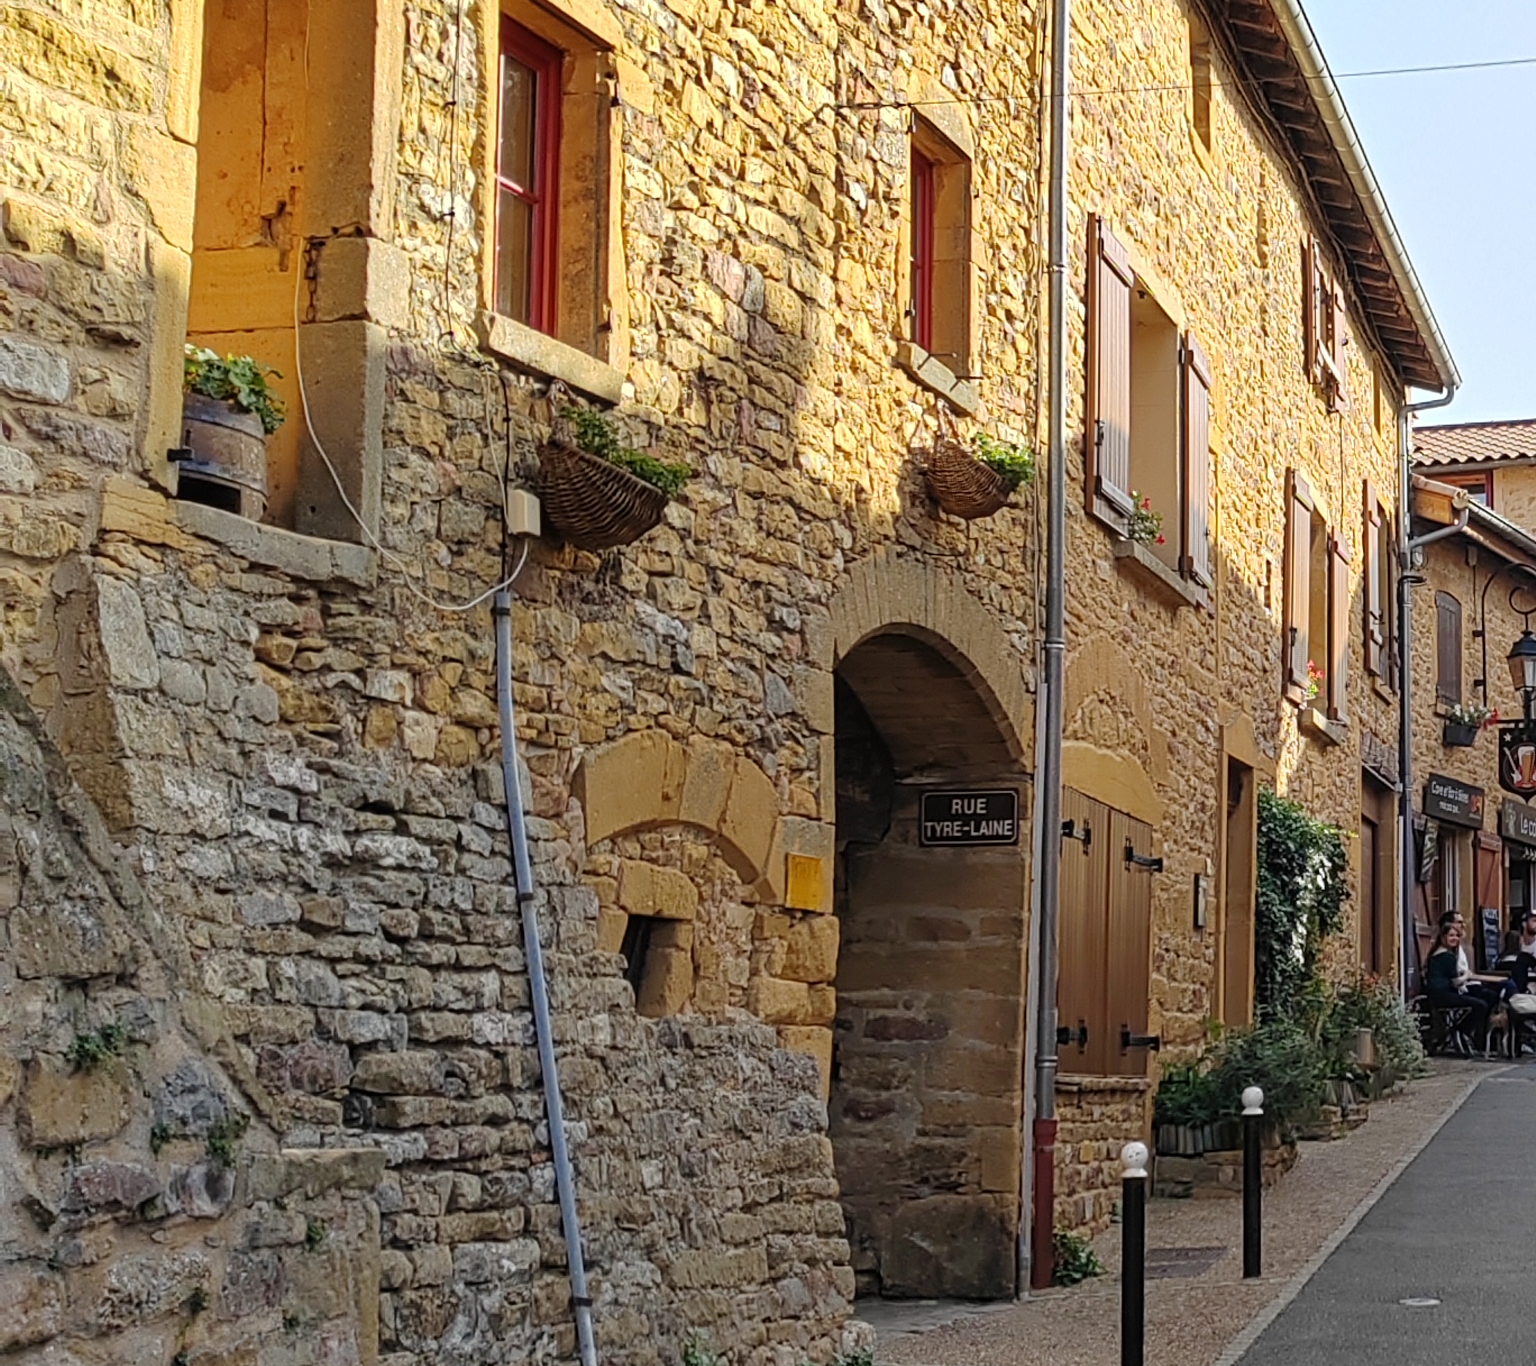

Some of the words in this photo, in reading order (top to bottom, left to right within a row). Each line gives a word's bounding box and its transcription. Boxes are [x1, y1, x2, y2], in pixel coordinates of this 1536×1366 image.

[951, 798, 987, 814] RUE
[924, 819, 1013, 838] TYRE-LAINE
[1520, 812, 1529, 835] Le
